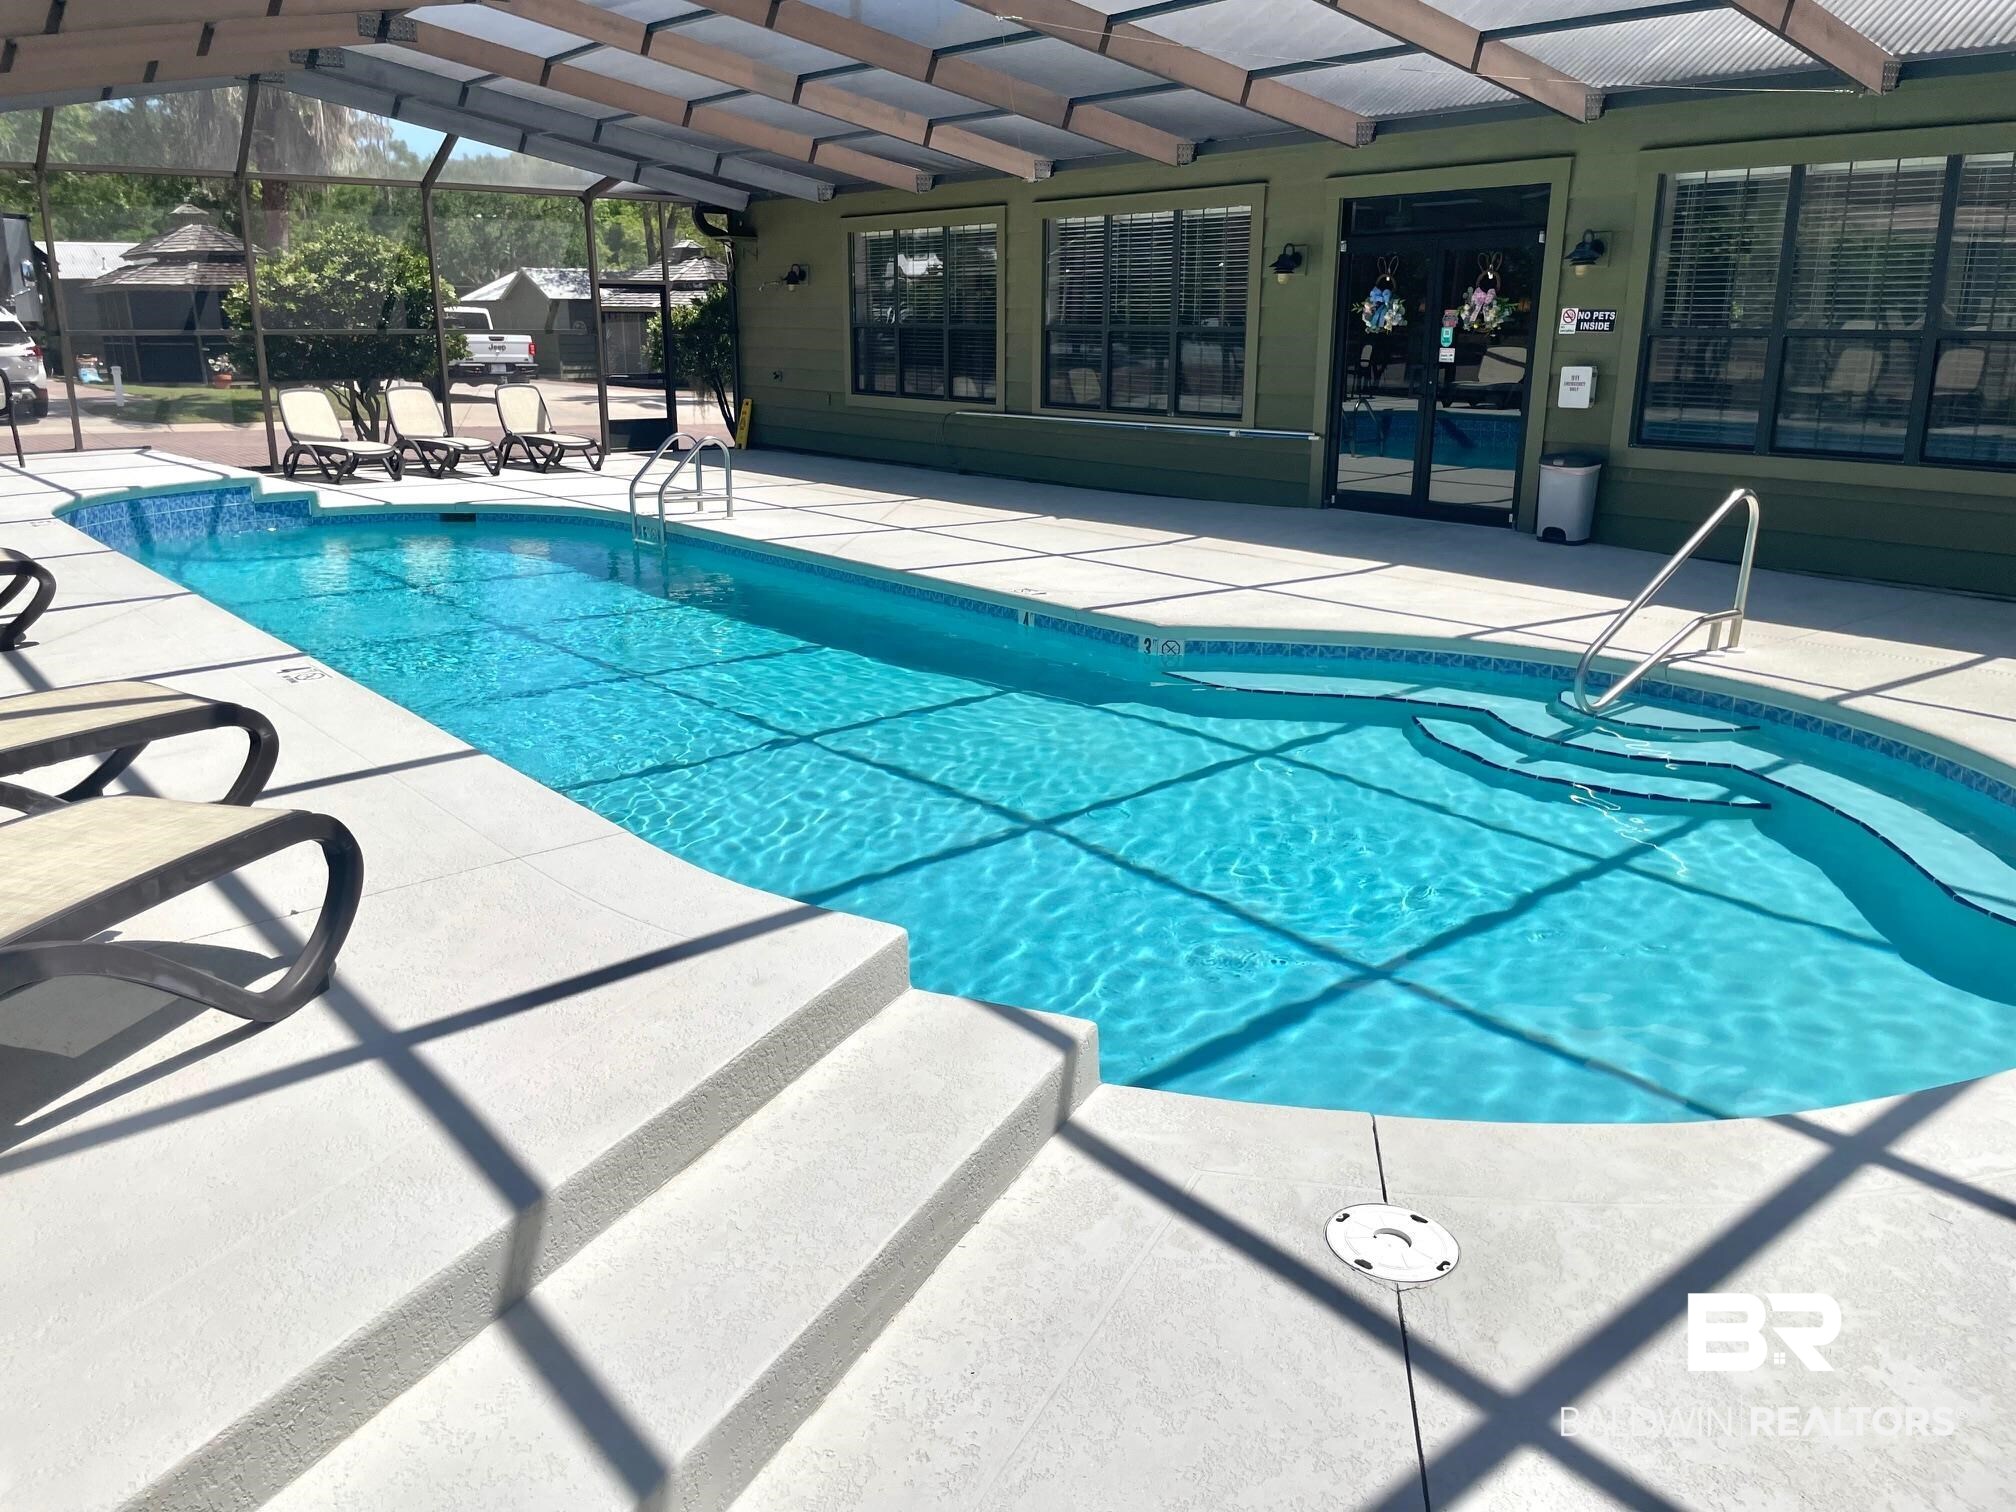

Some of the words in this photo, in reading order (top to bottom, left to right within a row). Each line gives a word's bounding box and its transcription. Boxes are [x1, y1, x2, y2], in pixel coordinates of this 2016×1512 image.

[1578, 311, 1591, 320] NO
[1593, 311, 1616, 320] PETS
[1580, 322, 1610, 331] INSIDE
[488, 343, 506, 352] Jeep
